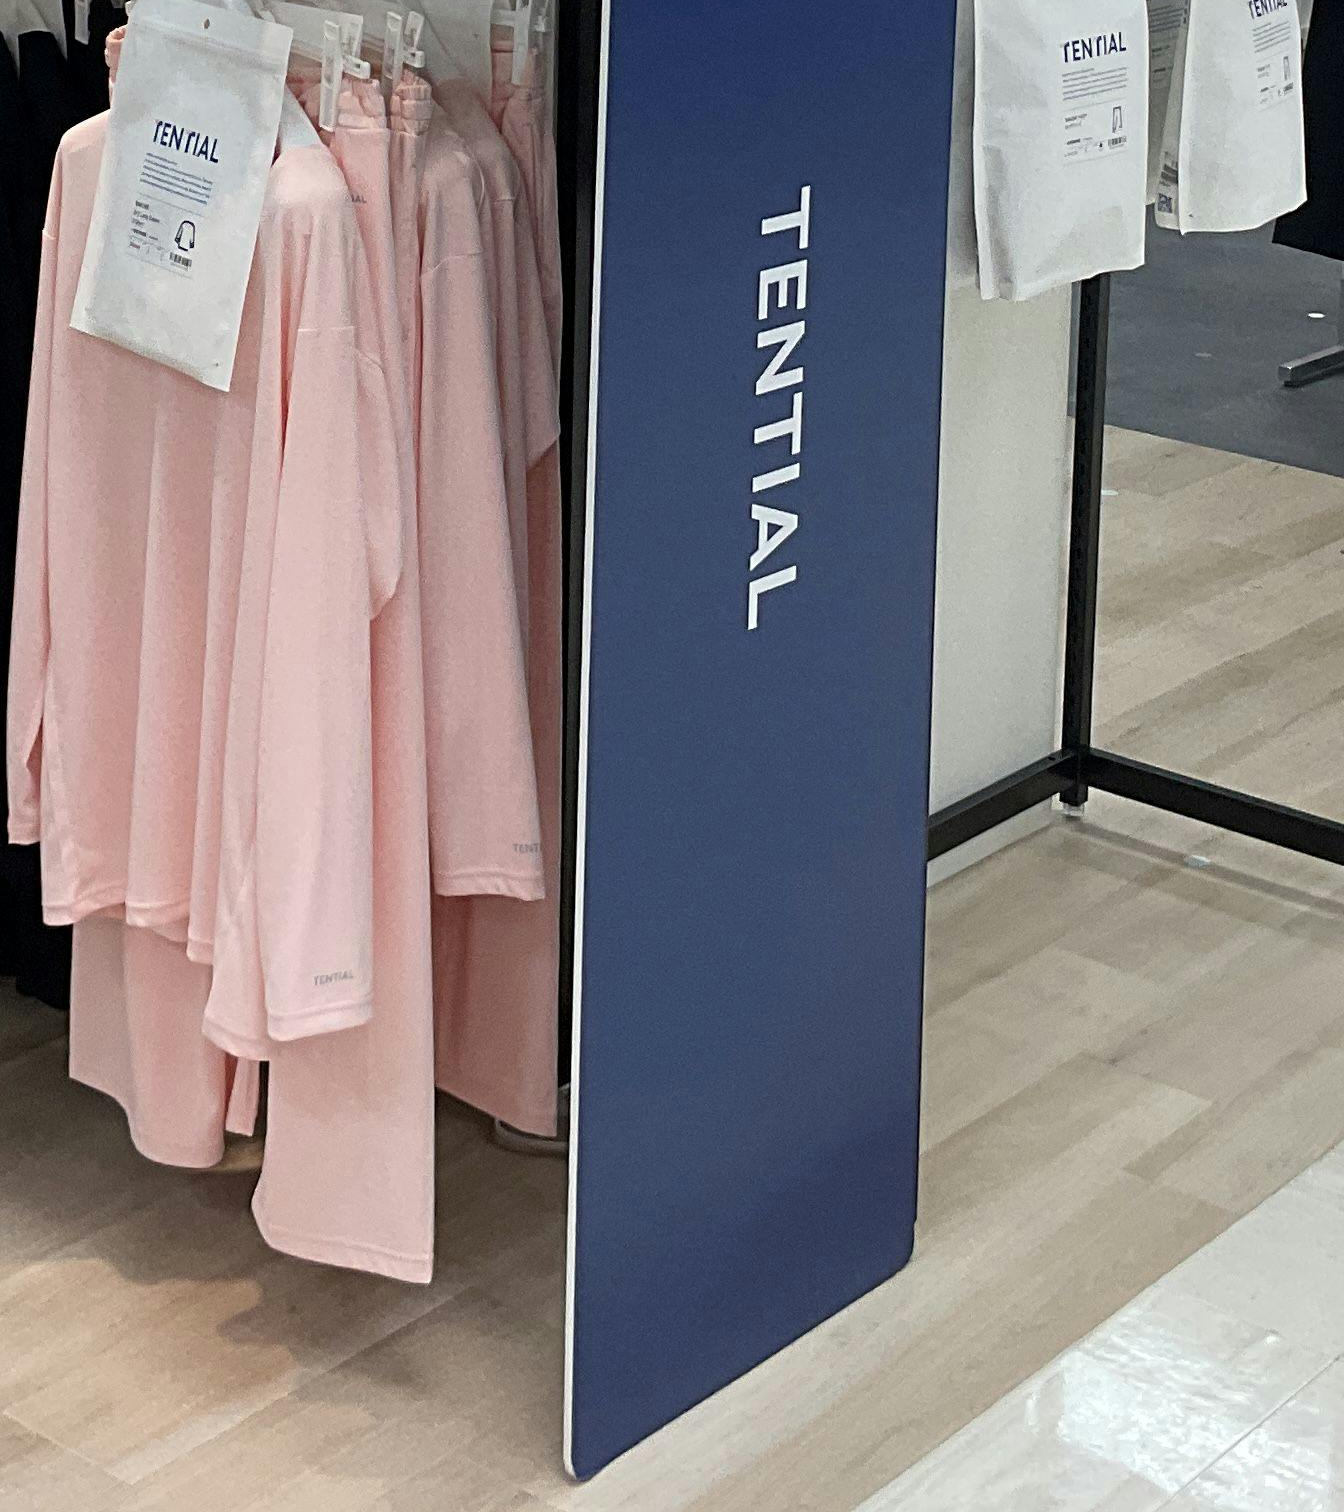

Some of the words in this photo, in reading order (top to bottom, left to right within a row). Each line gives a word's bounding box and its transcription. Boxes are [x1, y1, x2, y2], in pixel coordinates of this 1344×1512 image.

[1063, 31, 1127, 63] TENTIAL
[153, 120, 218, 163] TENTIAL
[748, 185, 811, 630] TENTIAL
[313, 969, 354, 986] TENTIAL
